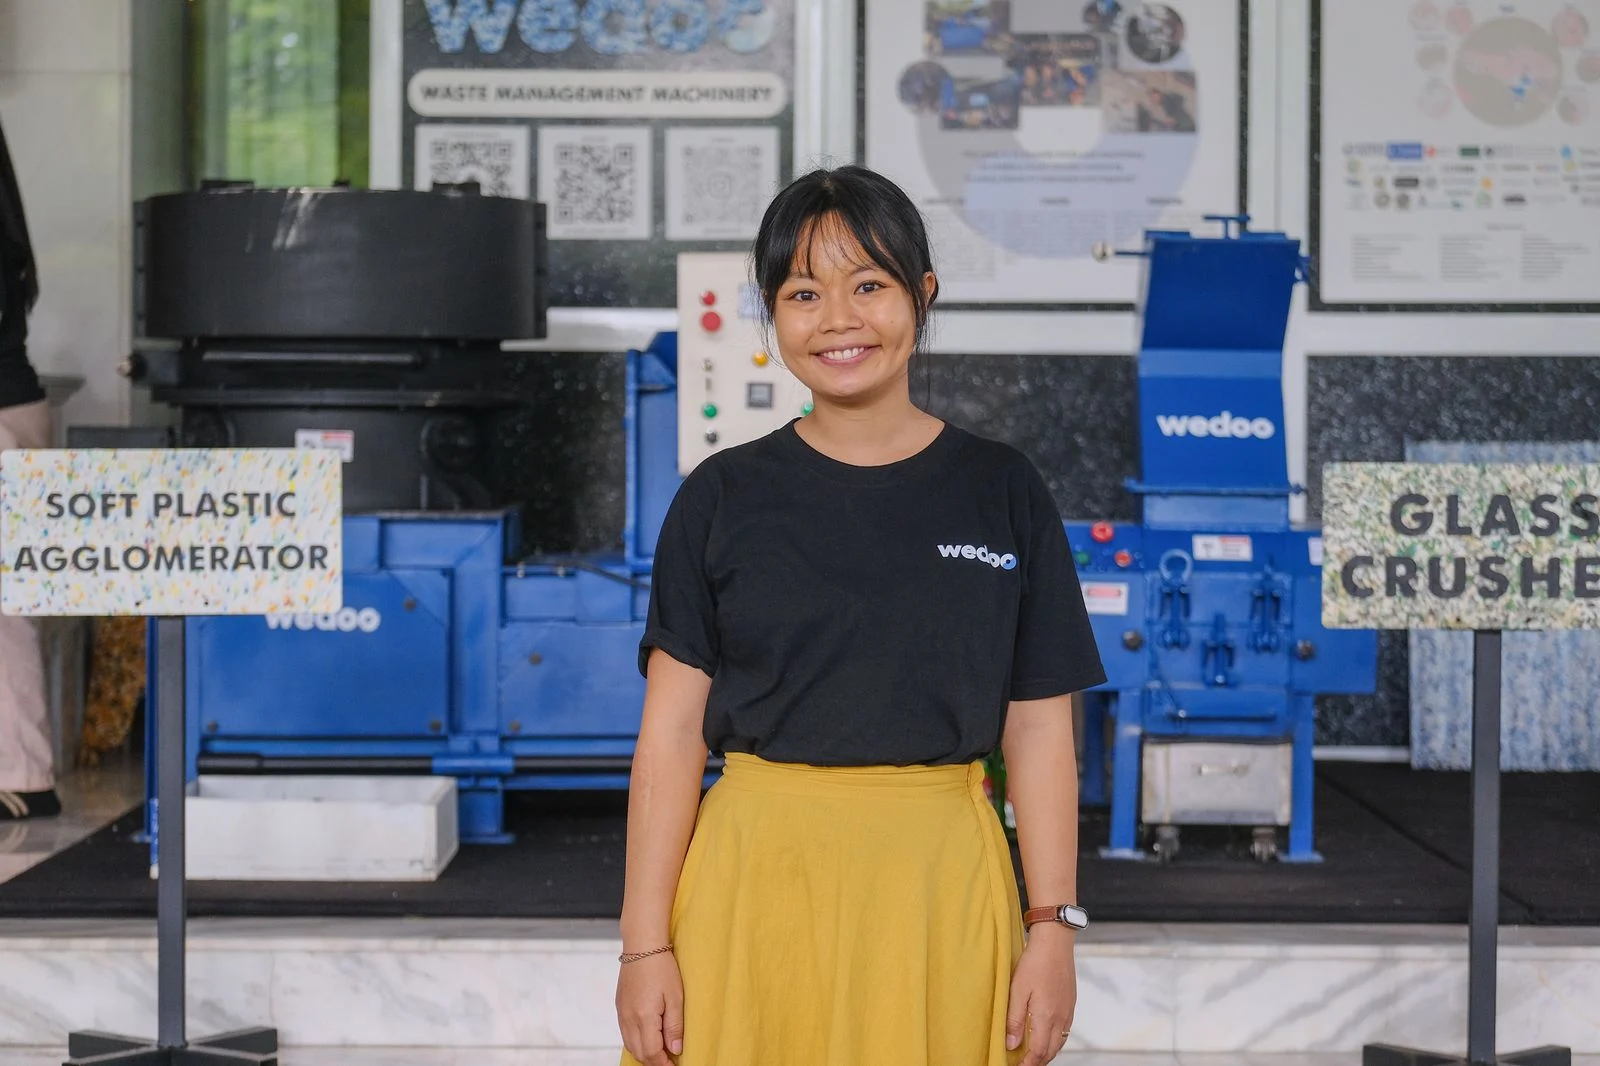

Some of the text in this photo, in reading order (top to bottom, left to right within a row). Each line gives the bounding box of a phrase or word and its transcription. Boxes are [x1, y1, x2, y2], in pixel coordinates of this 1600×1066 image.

[420, 85, 773, 102] WASTE MANAGEMENT MACHINERY
[1156, 410, 1275, 439] wedoo
[46, 492, 297, 518] SOFT PLASTIC
[1389, 493, 1600, 537] GLASS
[13, 544, 329, 572] AGGLOMERATOR
[937, 544, 1017, 570] wedoo
[1340, 556, 1600, 598] CRUSHE
